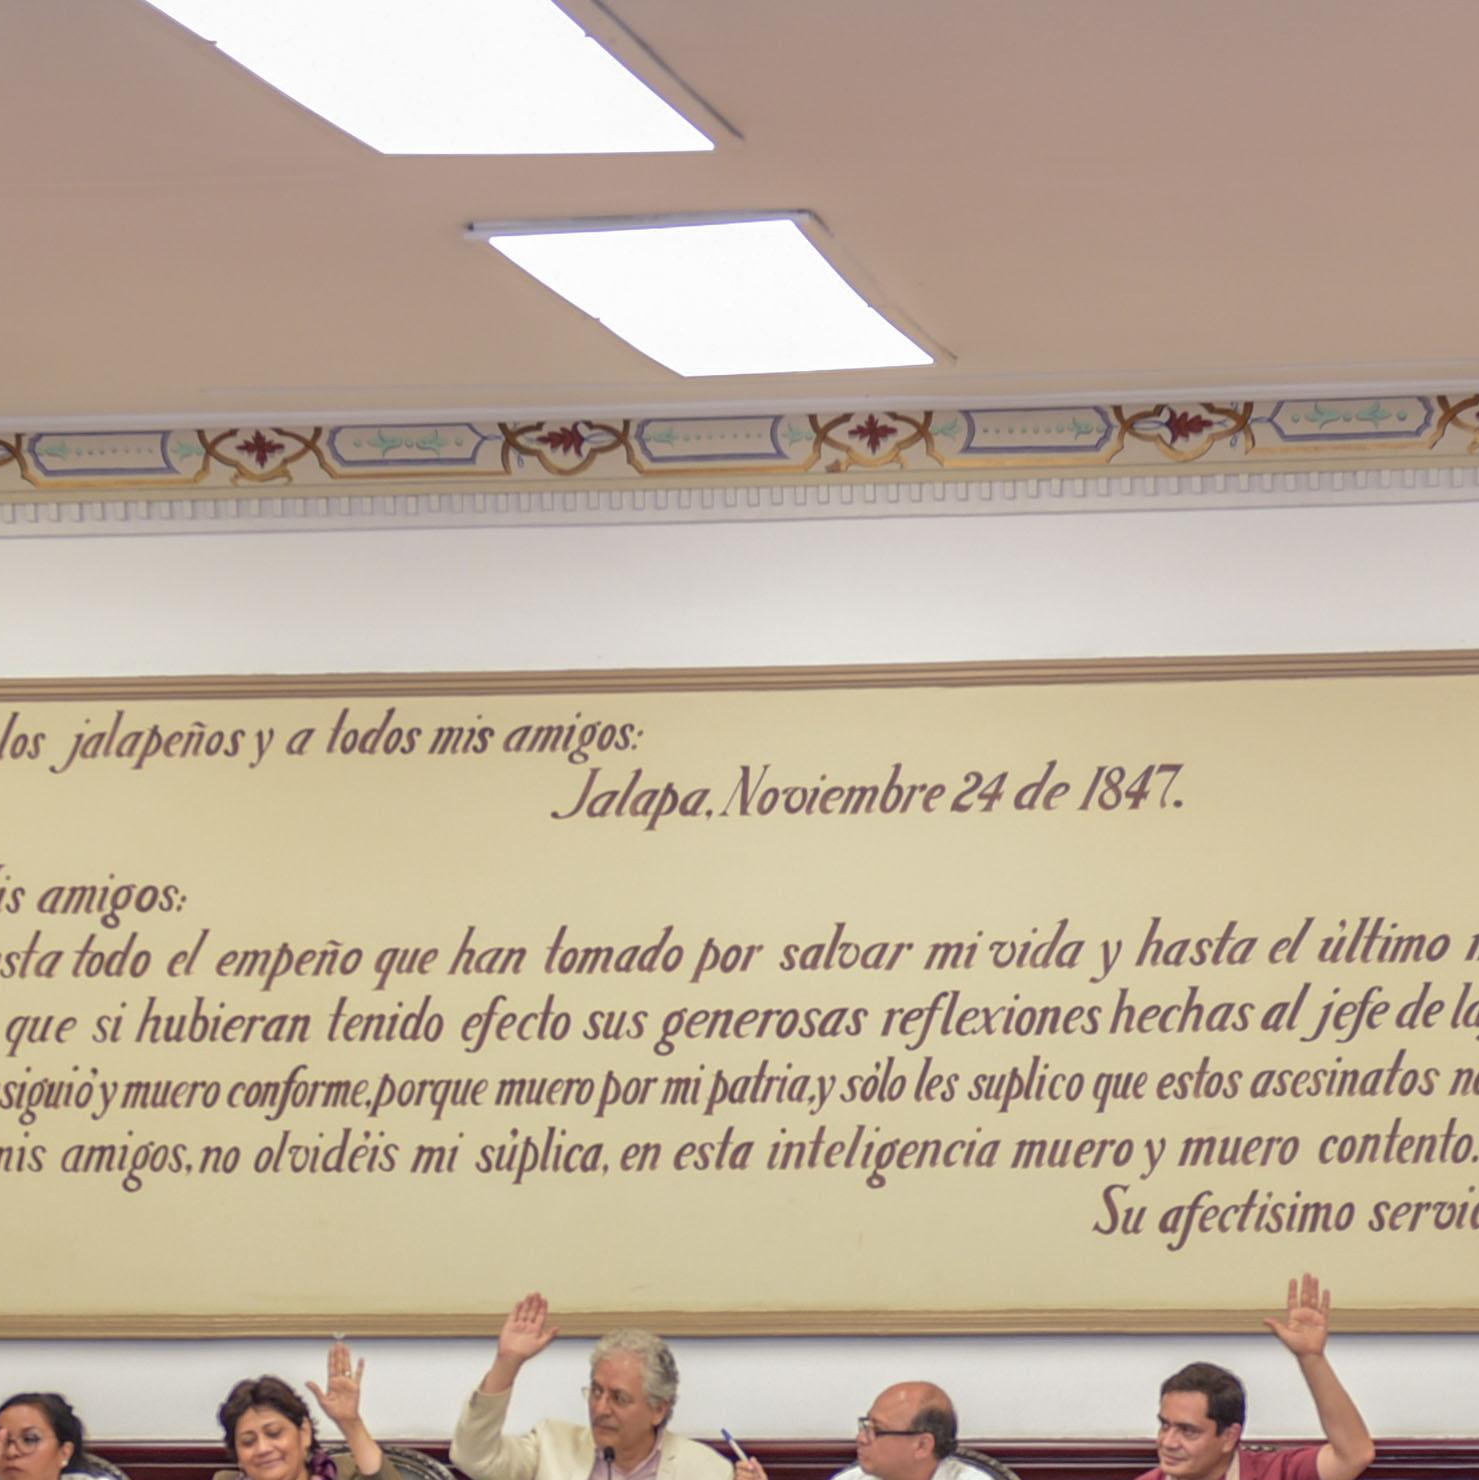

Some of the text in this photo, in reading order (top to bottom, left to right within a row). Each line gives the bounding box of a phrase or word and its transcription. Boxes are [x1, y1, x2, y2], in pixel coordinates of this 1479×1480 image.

[49, 710, 246, 774] jalapeños
[249, 728, 274, 769] y
[286, 728, 315, 755] a
[326, 707, 422, 755] todos
[428, 715, 495, 755] mis
[503, 712, 643, 764] amigos:
[719, 763, 946, 816] Noviembre
[950, 771, 1008, 813] 24
[1014, 760, 1070, 811] de
[37, 873, 187, 929] amigos:
[72, 932, 151, 978] todo
[167, 928, 210, 977] el
[215, 940, 363, 992] empeño
[374, 947, 439, 990] que
[448, 926, 527, 975] han
[544, 925, 684, 974] tomado
[690, 940, 764, 983] por
[779, 922, 914, 971] salvar
[924, 931, 983, 970] mi
[989, 918, 1085, 969] vida
[1089, 940, 1122, 984] y
[1135, 917, 1258, 967] hasta
[1268, 917, 1315, 964] el
[5, 1015, 77, 1057] que
[92, 1002, 127, 1043] si
[135, 996, 311, 1044] hubieran
[328, 995, 444, 1042] tenido
[461, 993, 571, 1053] efecto
[583, 1011, 648, 1040] sus
[653, 1007, 869, 1056] generosas
[881, 990, 1102, 1051] reflexiones
[1109, 986, 1255, 1034] hechas
[1260, 982, 1312, 1032] al
[1300, 986, 1390, 1043] jefe
[1395, 981, 1445, 1030] de
[120, 1080, 221, 1109] muero
[495, 1078, 595, 1106] muero
[594, 1070, 658, 1118] por
[661, 1064, 705, 1105] mi
[914, 1056, 959, 1102] les
[967, 1055, 1085, 1113] suplico
[1093, 1072, 1148, 1113] que
[1156, 1056, 1243, 1100] estos
[1250, 1048, 1440, 1099] asesinatos
[199, 1146, 241, 1174] no
[410, 1132, 464, 1174] mi
[620, 1142, 661, 1171] en
[673, 1126, 754, 1171] esta
[767, 1125, 1001, 1189] inteligencia
[1011, 1139, 1134, 1169] muero
[1140, 1137, 1166, 1180] y
[1178, 1136, 1300, 1166] muero
[1318, 1117, 1479, 1164] contento.
[1092, 1184, 1147, 1235] Su
